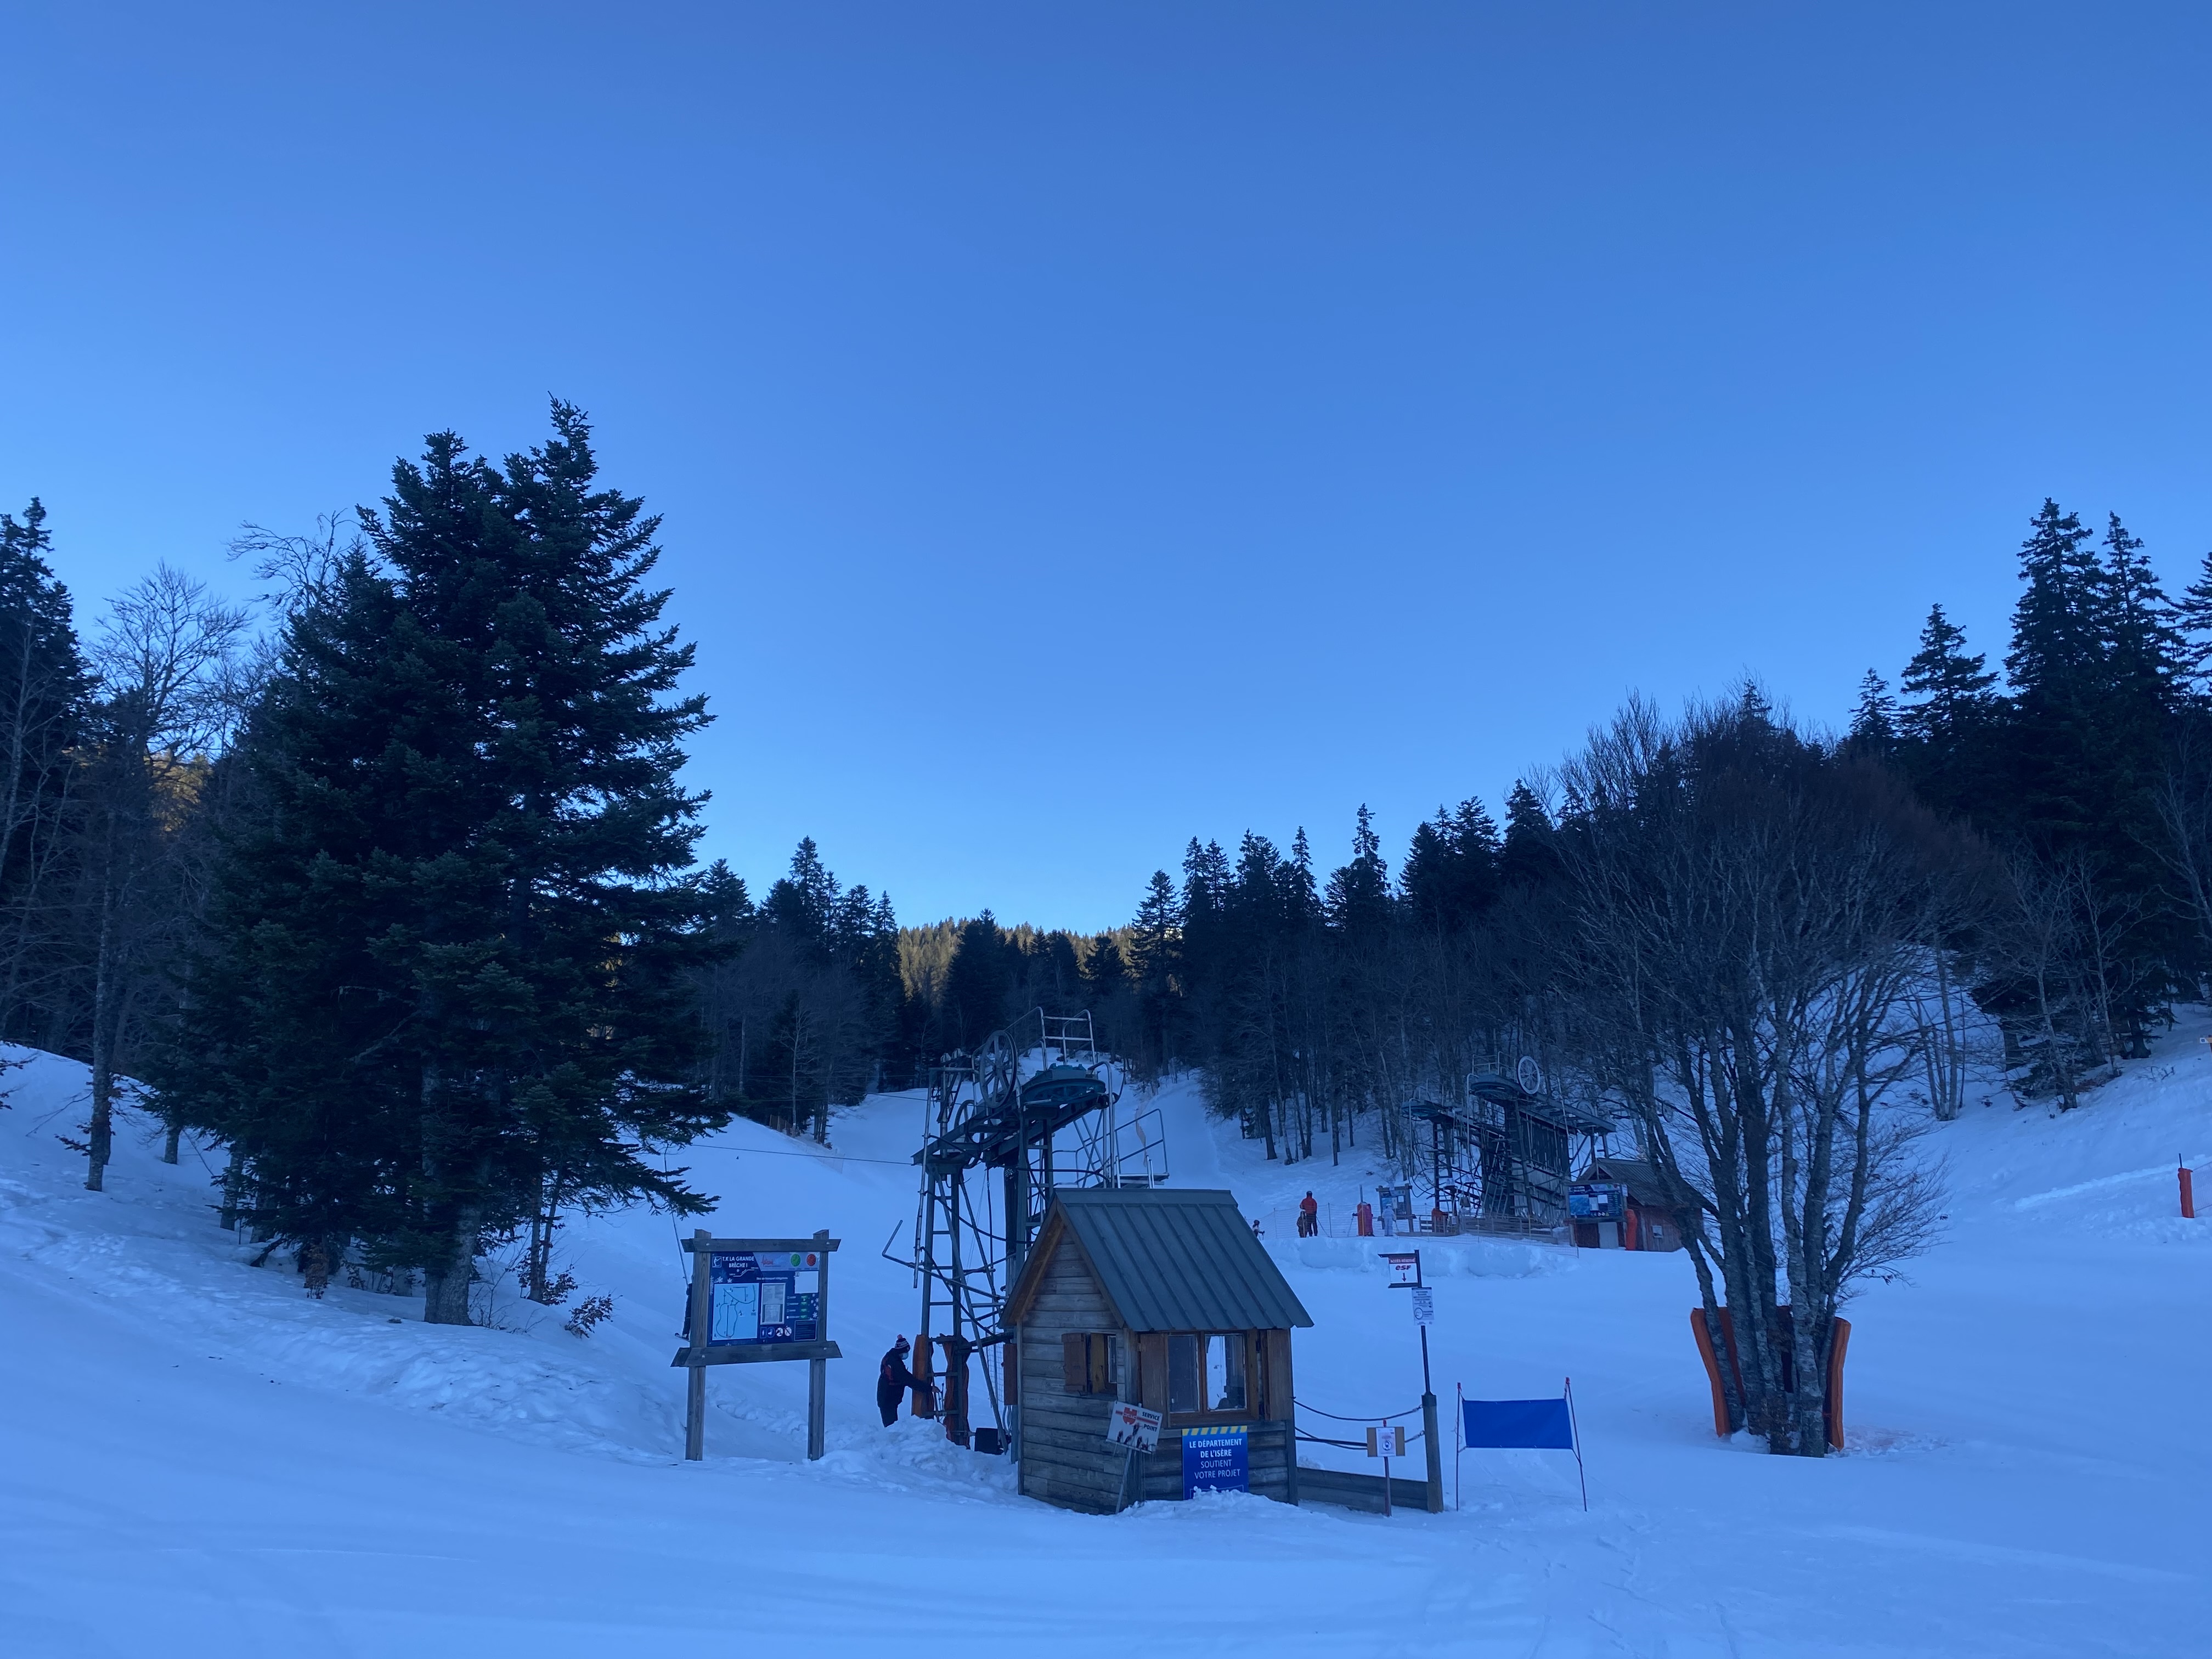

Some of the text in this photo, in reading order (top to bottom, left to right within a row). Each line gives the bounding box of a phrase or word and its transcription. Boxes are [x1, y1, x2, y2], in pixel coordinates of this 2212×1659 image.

[1142, 1412, 1160, 1421] SERVICE
[1144, 1424, 1158, 1432] POINT
[1198, 1438, 1242, 1448] DÉPARTEMENT
[1210, 1448, 1232, 1458] L'ISÈRE
[1200, 1459, 1232, 1469] SOUTIENT
[1194, 1469, 1240, 1480] VOTRE PROJET
